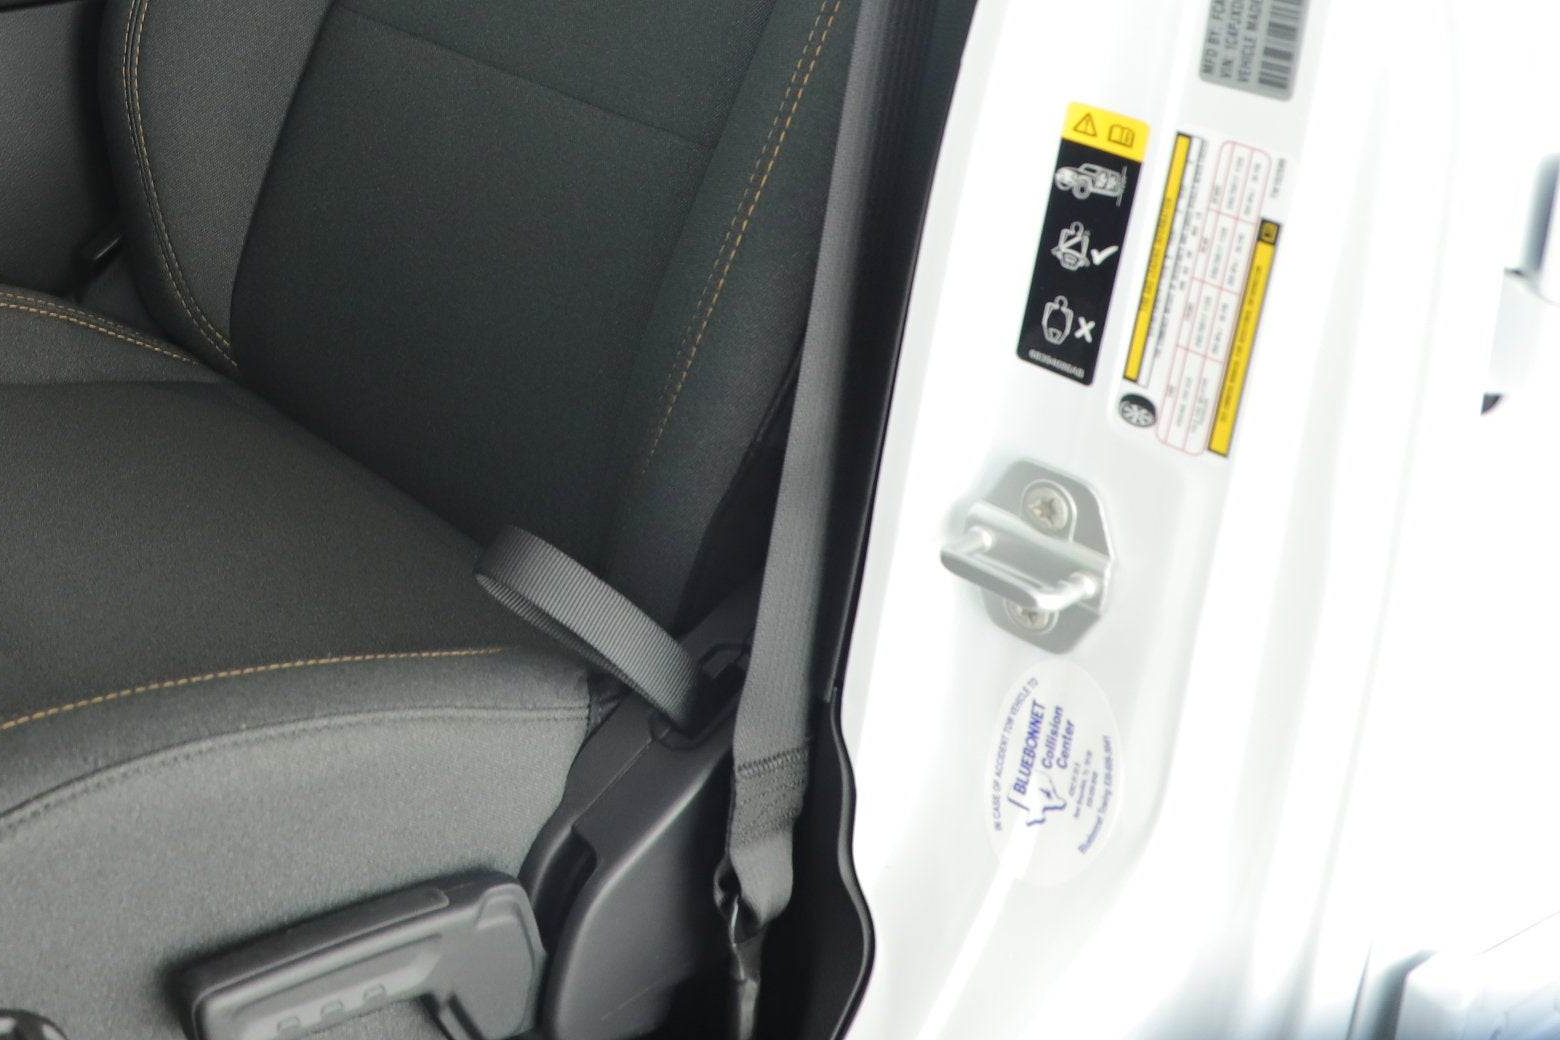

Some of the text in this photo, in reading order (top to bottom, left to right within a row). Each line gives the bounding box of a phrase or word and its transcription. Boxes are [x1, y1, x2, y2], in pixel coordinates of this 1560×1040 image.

[1201, 48, 1219, 75] MFD
[1236, 35, 1256, 83] VEHICLE
[1010, 686, 1031, 716] VEHICLE
[995, 734, 1009, 778] ACCIDENT
[1013, 699, 1046, 795] BLUEBONNET
[1042, 705, 1064, 770] Collision
[1056, 719, 1075, 770] Center
[993, 779, 1001, 792] OF
[993, 794, 1001, 819] CASE
